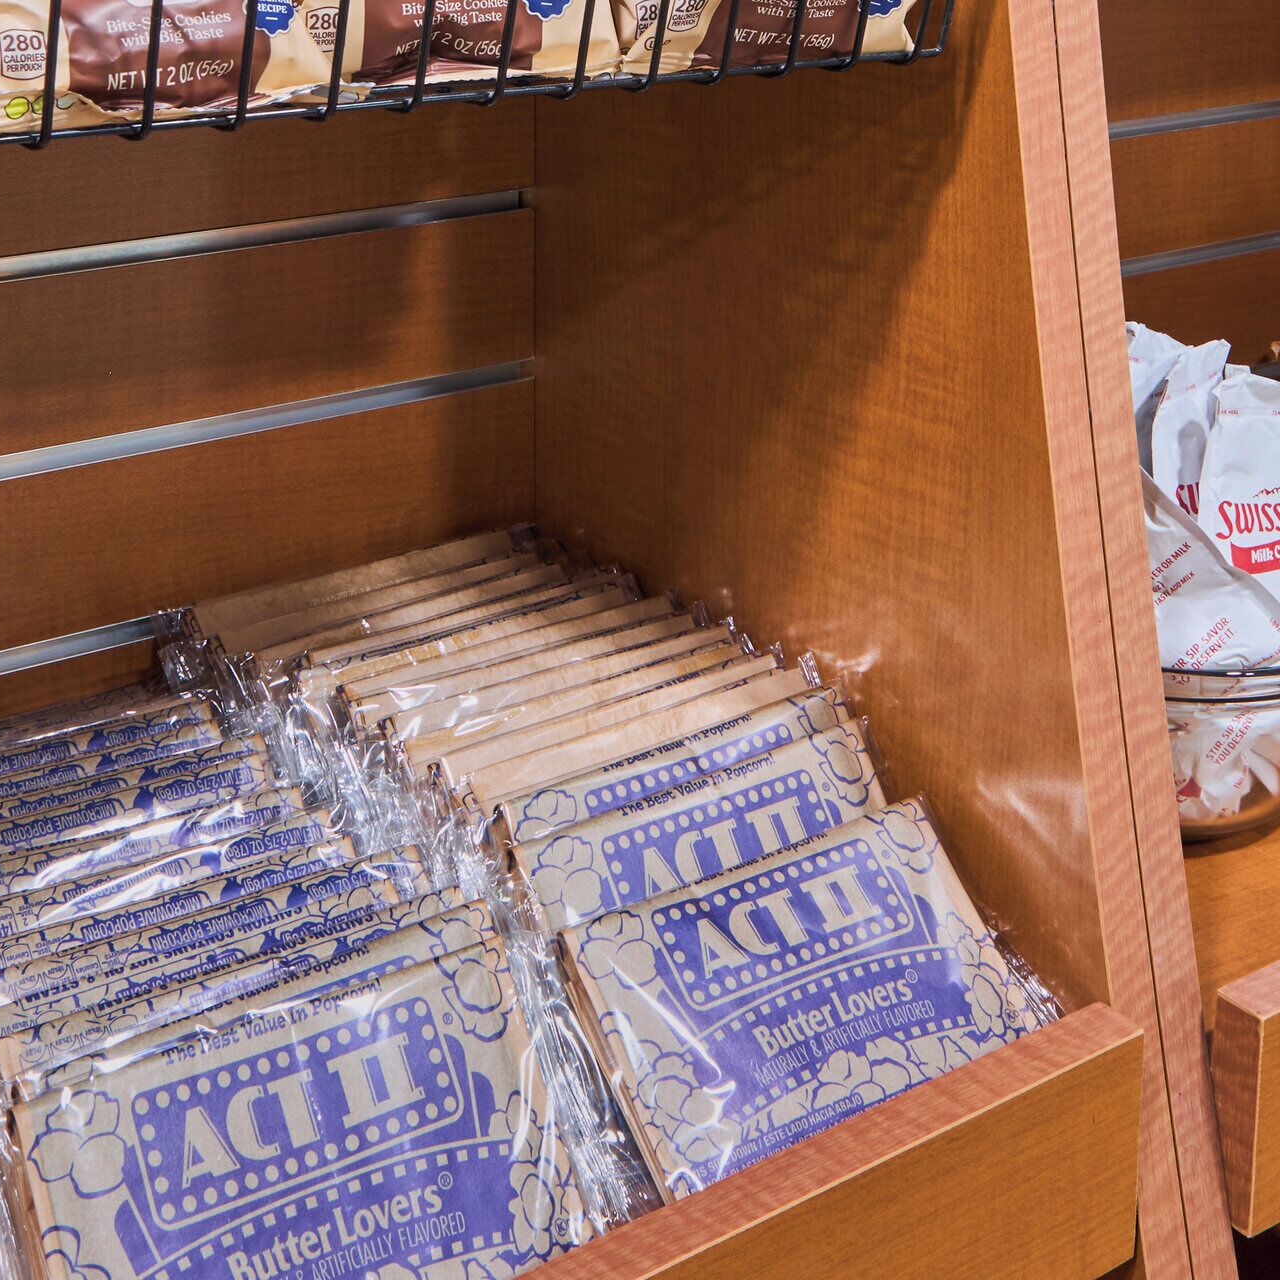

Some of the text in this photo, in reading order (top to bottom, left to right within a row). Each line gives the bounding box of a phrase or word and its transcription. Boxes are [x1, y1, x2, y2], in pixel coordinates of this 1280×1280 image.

[179, 11, 232, 29] Cookies
[471, 11, 503, 24] Taste
[757, 5, 835, 18] with Taste
[2, 34, 41, 52] 280
[187, 26, 224, 41] Taste
[454, 37, 473, 55] OZ
[733, 27, 836, 48] NET (56g)
[3, 54, 46, 64] CALORIES
[21, 63, 43, 72] POUCH
[107, 59, 233, 91] NET OZ (56g)
[1162, 541, 1192, 570] OR MILK
[1251, 549, 1274, 564] Milk
[1169, 571, 1195, 597] ADD MILK
[1191, 638, 1223, 672] DESERVE
[702, 713, 752, 740] Popcorn!
[13, 743, 71, 770] MICROWAVE
[1214, 745, 1231, 767] YOU
[155, 767, 255, 804] NET OZ (78g)
[619, 752, 775, 817] The Best Value In Popcorn!
[1, 799, 118, 846] MICROWAVE POPCORN
[643, 818, 743, 898] ACT
[745, 795, 809, 854] II
[82, 893, 204, 943] MICROWAVE POPCORN
[150, 899, 269, 952] MICROWAVE POPCORN
[697, 887, 810, 980] ACT
[799, 863, 884, 934] II
[752, 978, 913, 1058] Butter Lovers
[162, 1005, 309, 1067] The Value In
[753, 999, 936, 1088] NATURALLY & ARTIFICIALLY FLAVORED
[182, 1031, 426, 1190] ACT II
[731, 1094, 863, 1161] DOWN ESTE LADO HACIA ABAJO
[225, 1184, 443, 1280] Butter Lovers
[311, 1211, 466, 1280] ARTIFICIALLY FLAVORED
